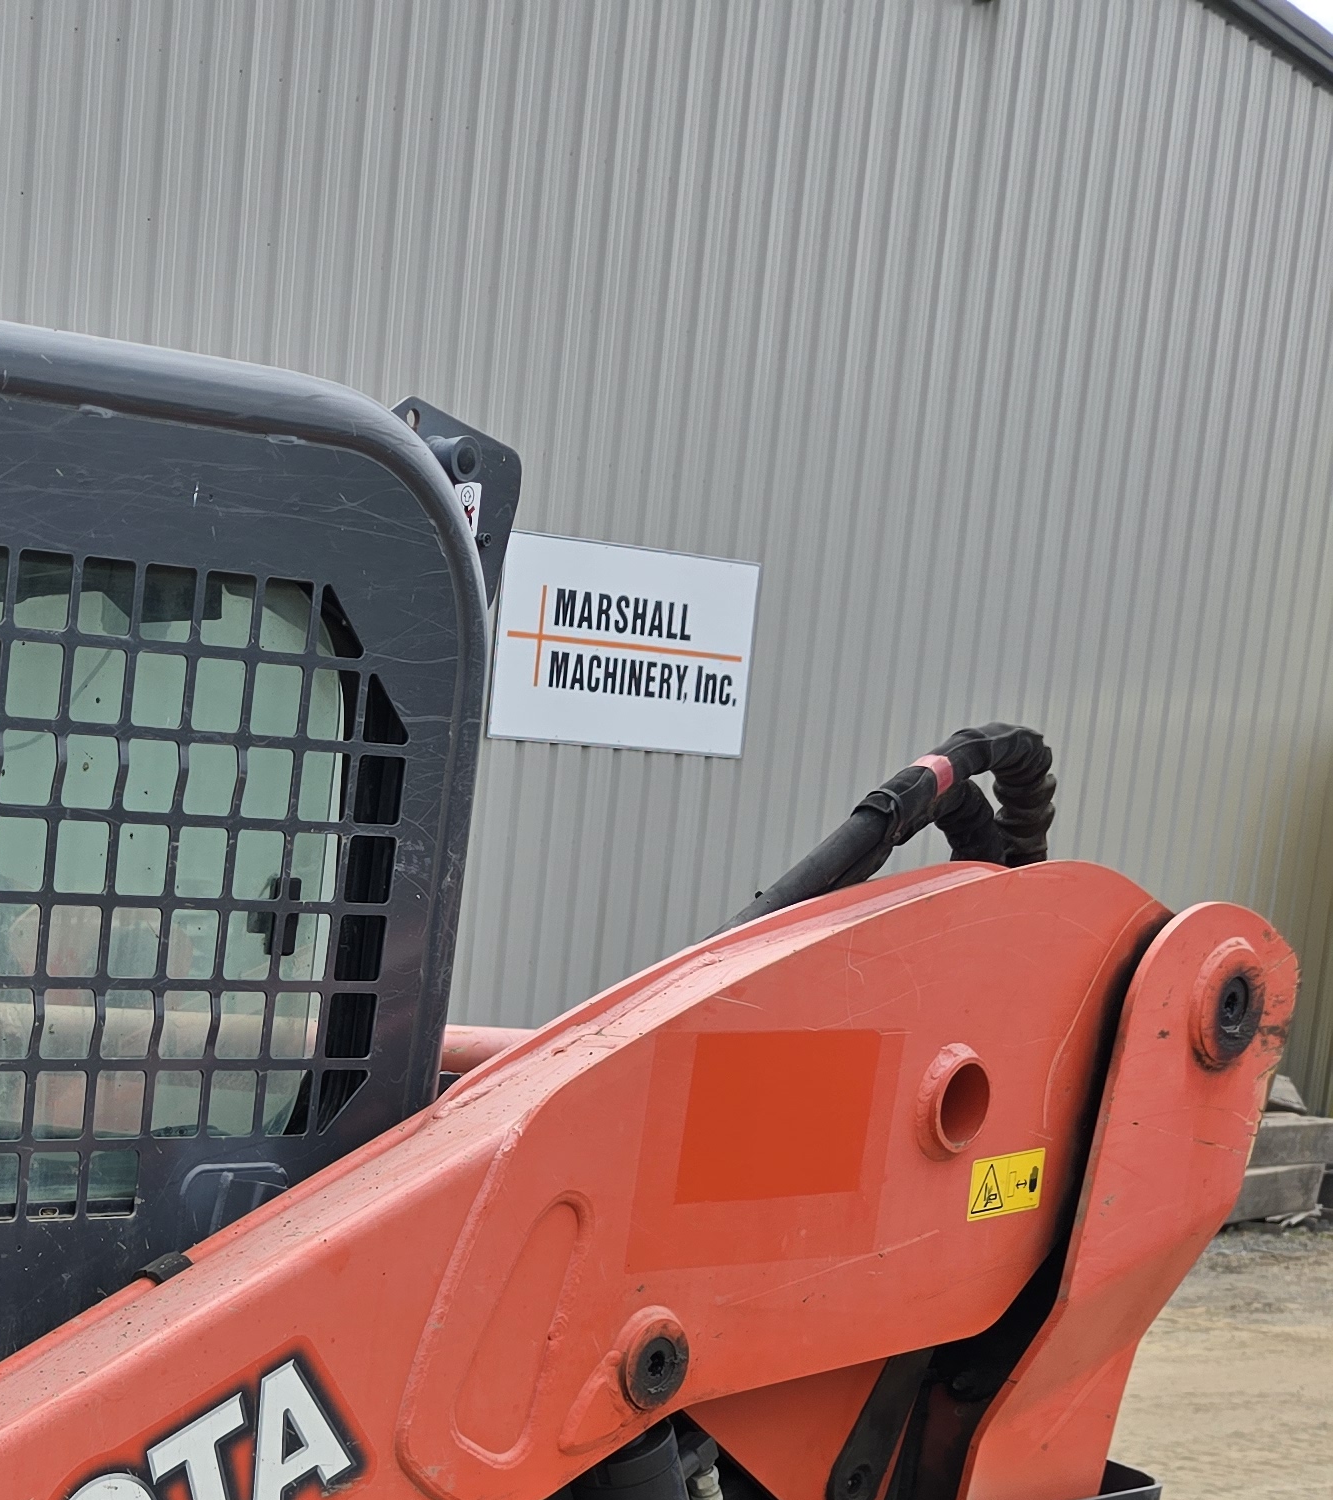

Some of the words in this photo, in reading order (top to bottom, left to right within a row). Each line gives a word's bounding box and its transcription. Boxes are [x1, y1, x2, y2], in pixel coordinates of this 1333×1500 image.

[553, 588, 691, 641] MARSHALL
[548, 651, 688, 704] MACHINERY,
[694, 666, 737, 707] Inc.
